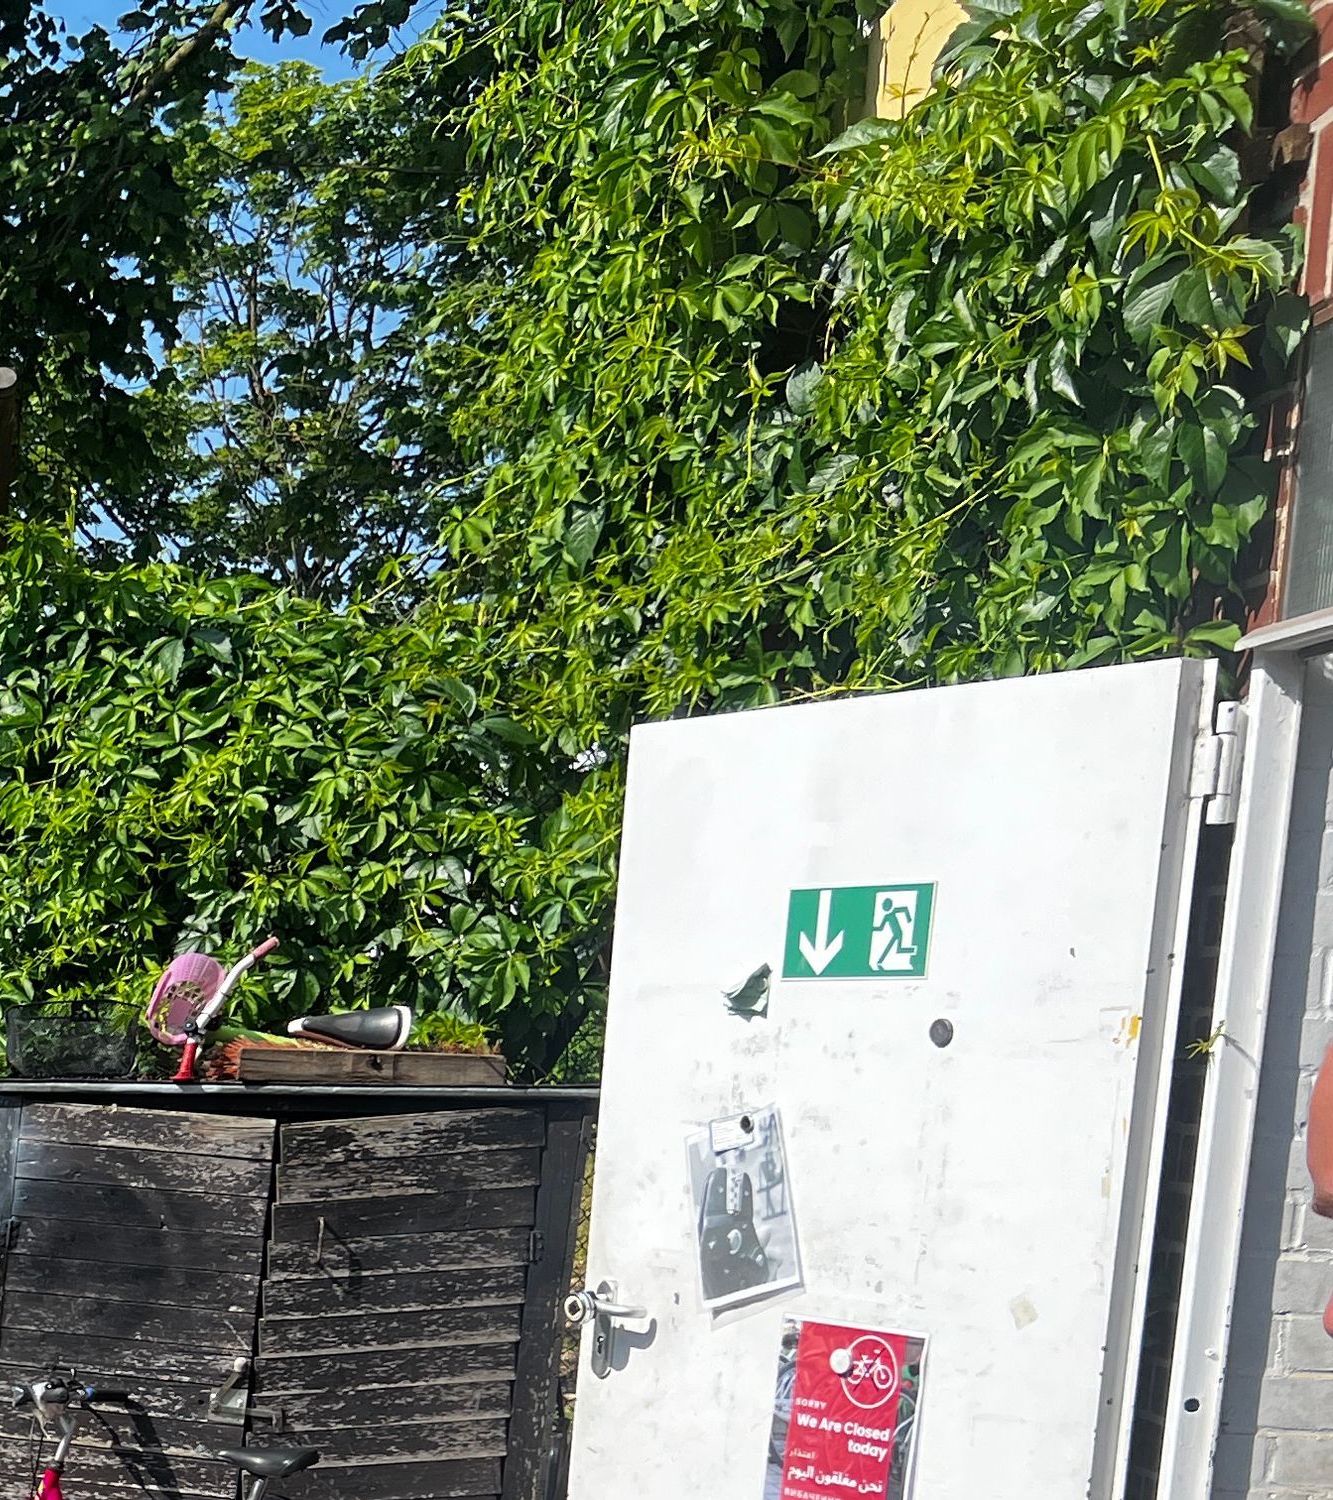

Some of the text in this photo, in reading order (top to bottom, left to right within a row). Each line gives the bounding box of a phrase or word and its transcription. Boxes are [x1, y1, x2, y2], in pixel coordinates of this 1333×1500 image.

[795, 1397, 827, 1410] SORRY
[797, 1413, 891, 1442] We Are Closed
[847, 1439, 888, 1463] today
[787, 1465, 883, 1494] نحن مغلقون اليوم
